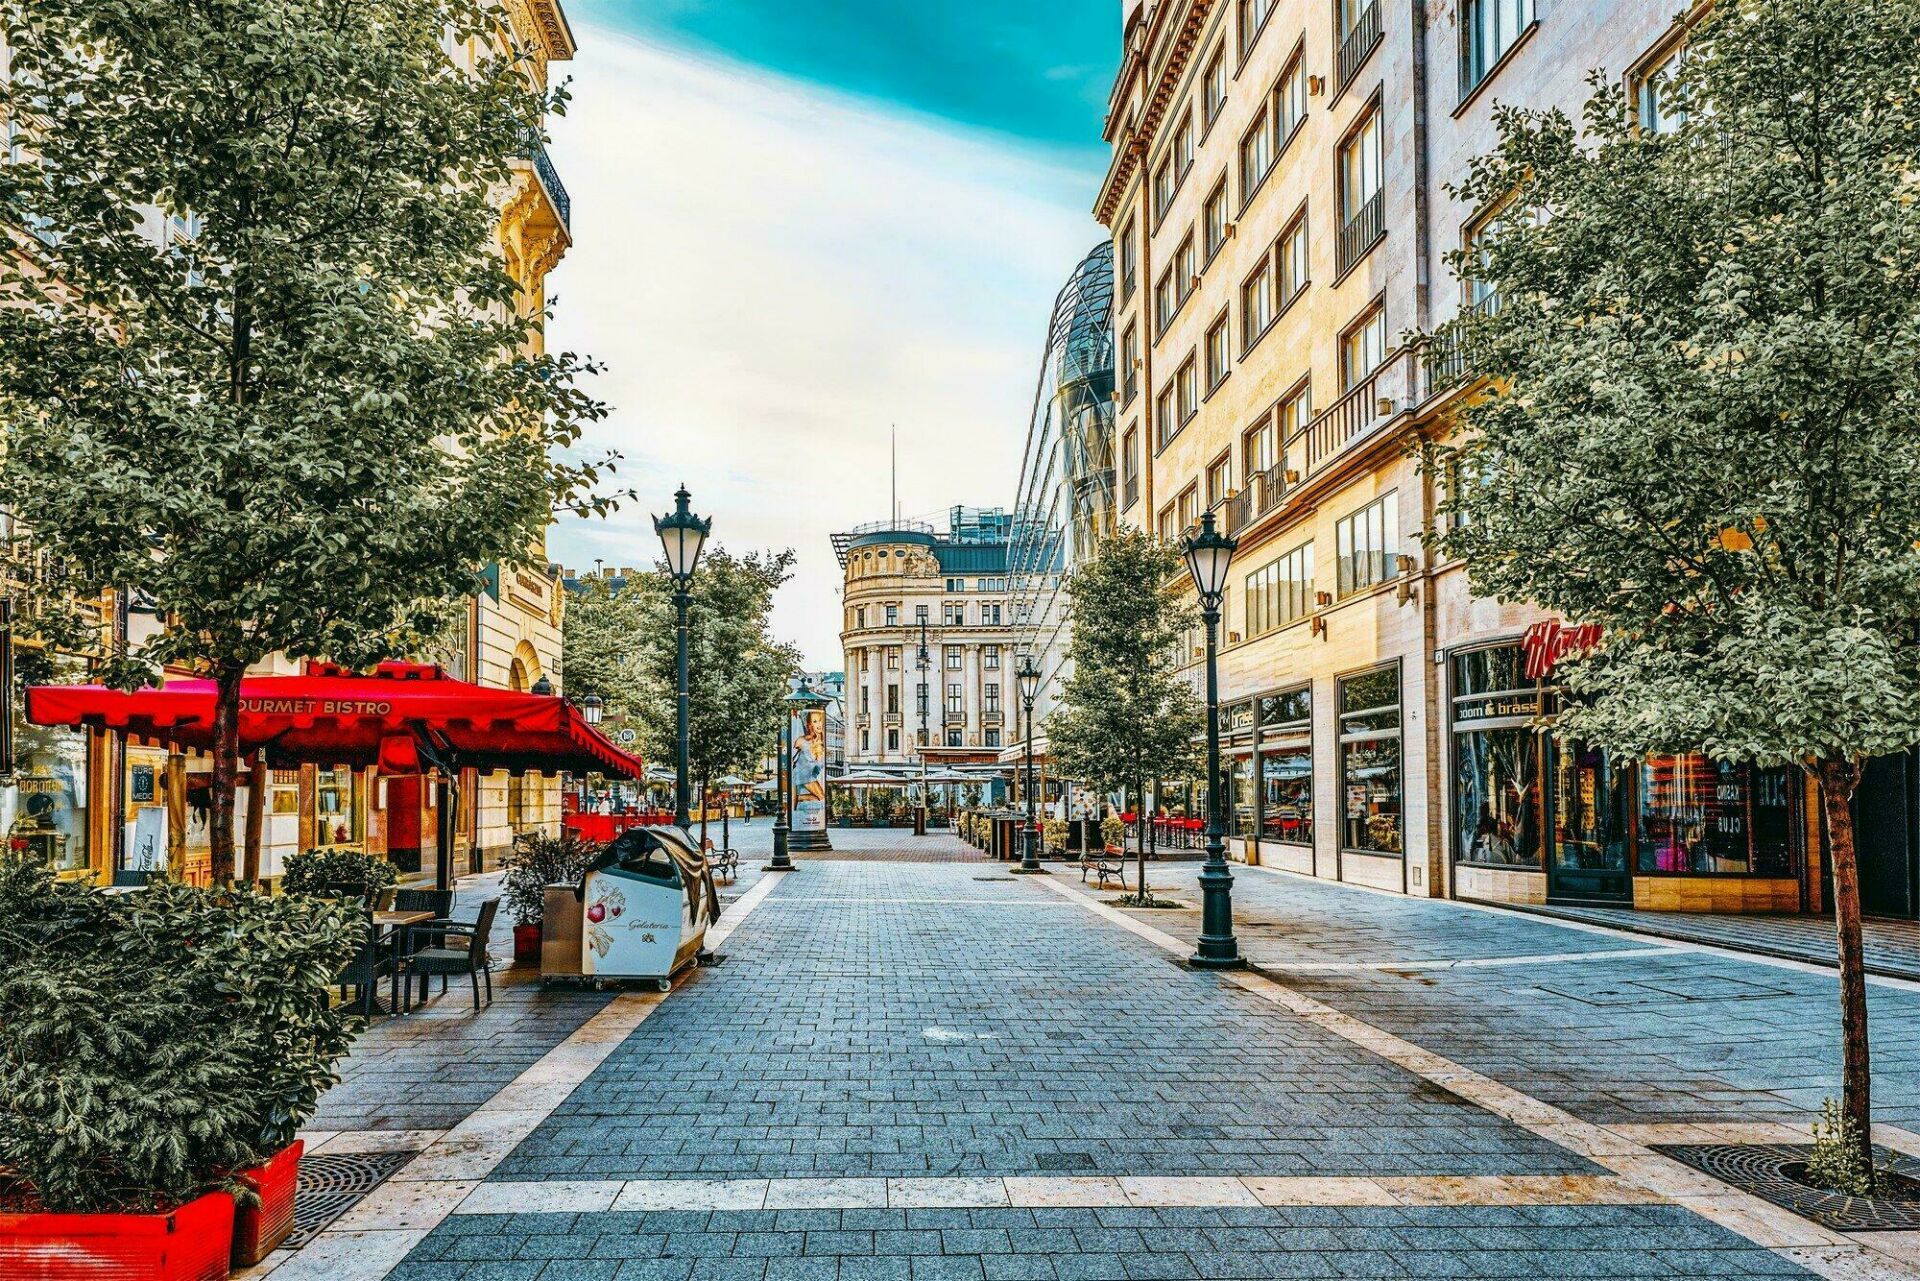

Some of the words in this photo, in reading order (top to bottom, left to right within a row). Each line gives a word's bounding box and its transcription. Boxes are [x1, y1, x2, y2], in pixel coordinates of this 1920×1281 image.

[239, 700, 316, 713] OURMET
[324, 702, 390, 715] BISTRO
[1498, 703, 1538, 715] brass
[132, 792, 153, 800] MEDIC
[628, 919, 670, 931] Gelateria
